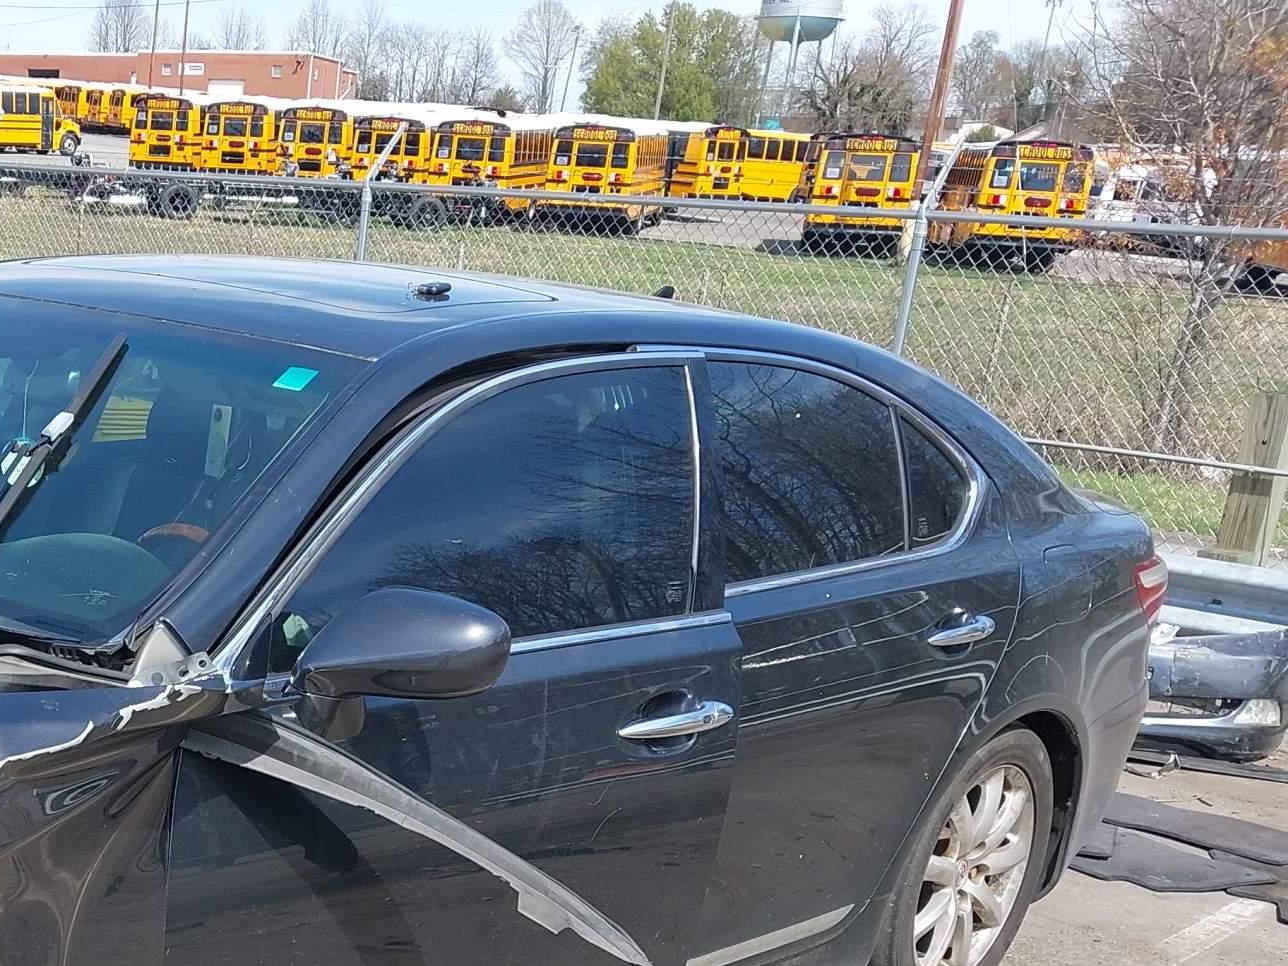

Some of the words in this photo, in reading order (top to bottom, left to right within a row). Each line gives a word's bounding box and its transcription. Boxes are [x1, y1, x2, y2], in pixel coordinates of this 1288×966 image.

[848, 139, 879, 150] SCHOOL
[881, 140, 897, 150] BUS
[1018, 146, 1050, 158] SCHOOL
[1054, 147, 1072, 159] BUS
